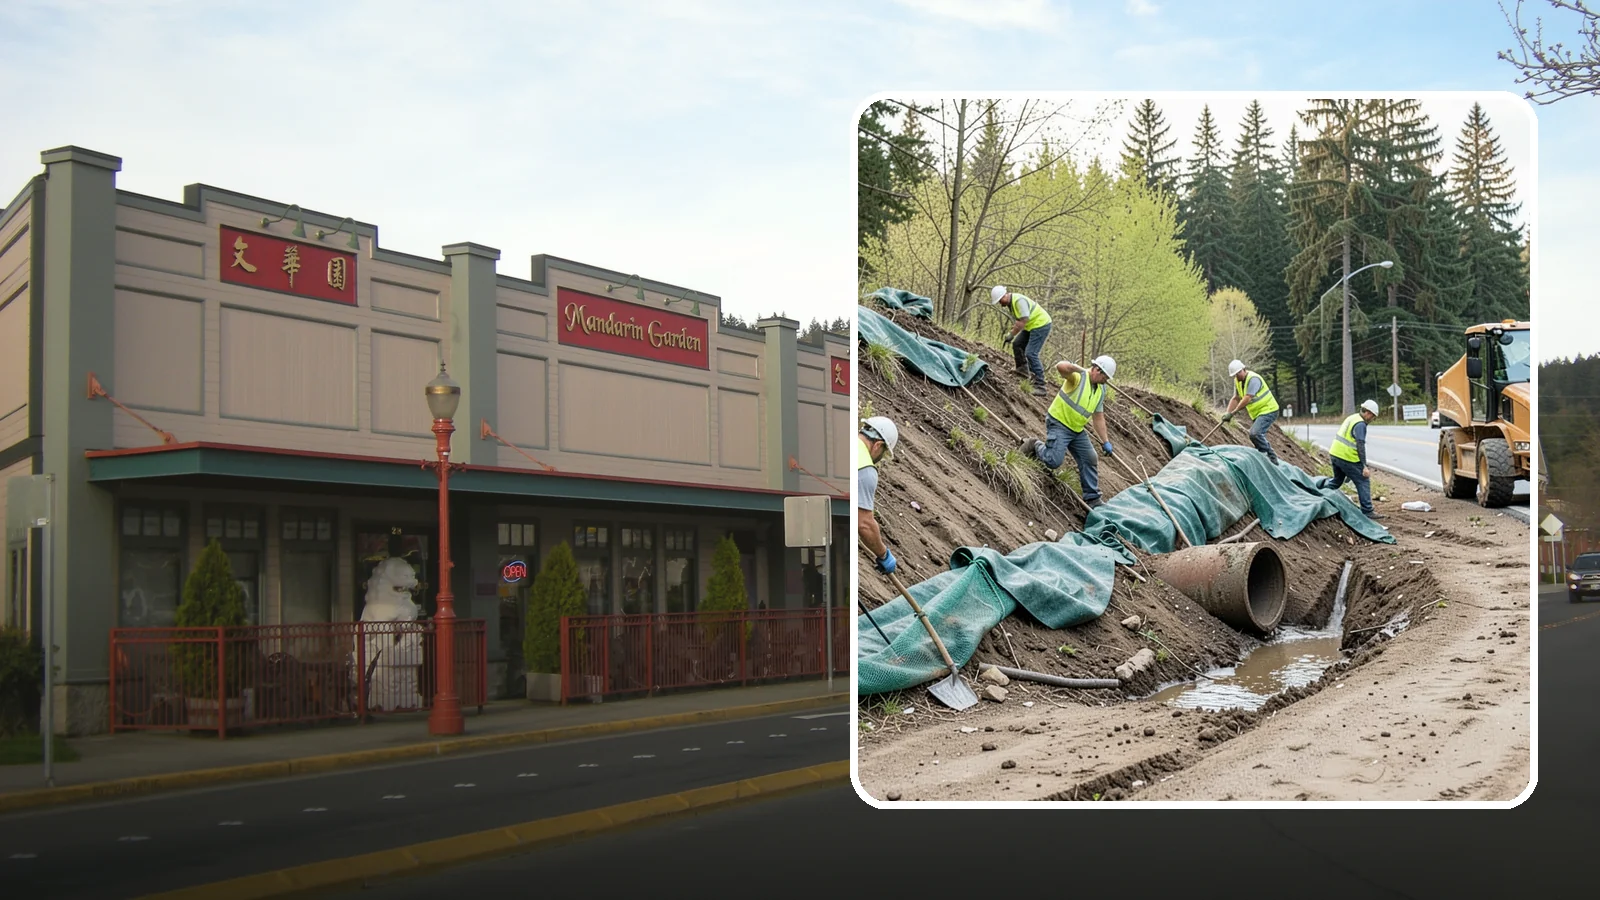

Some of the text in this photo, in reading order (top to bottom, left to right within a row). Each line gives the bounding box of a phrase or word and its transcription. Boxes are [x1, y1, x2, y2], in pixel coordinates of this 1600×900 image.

[230, 235, 346, 291] 文華園
[564, 302, 701, 352] Mandarin Garden
[503, 564, 527, 579] OPEN
